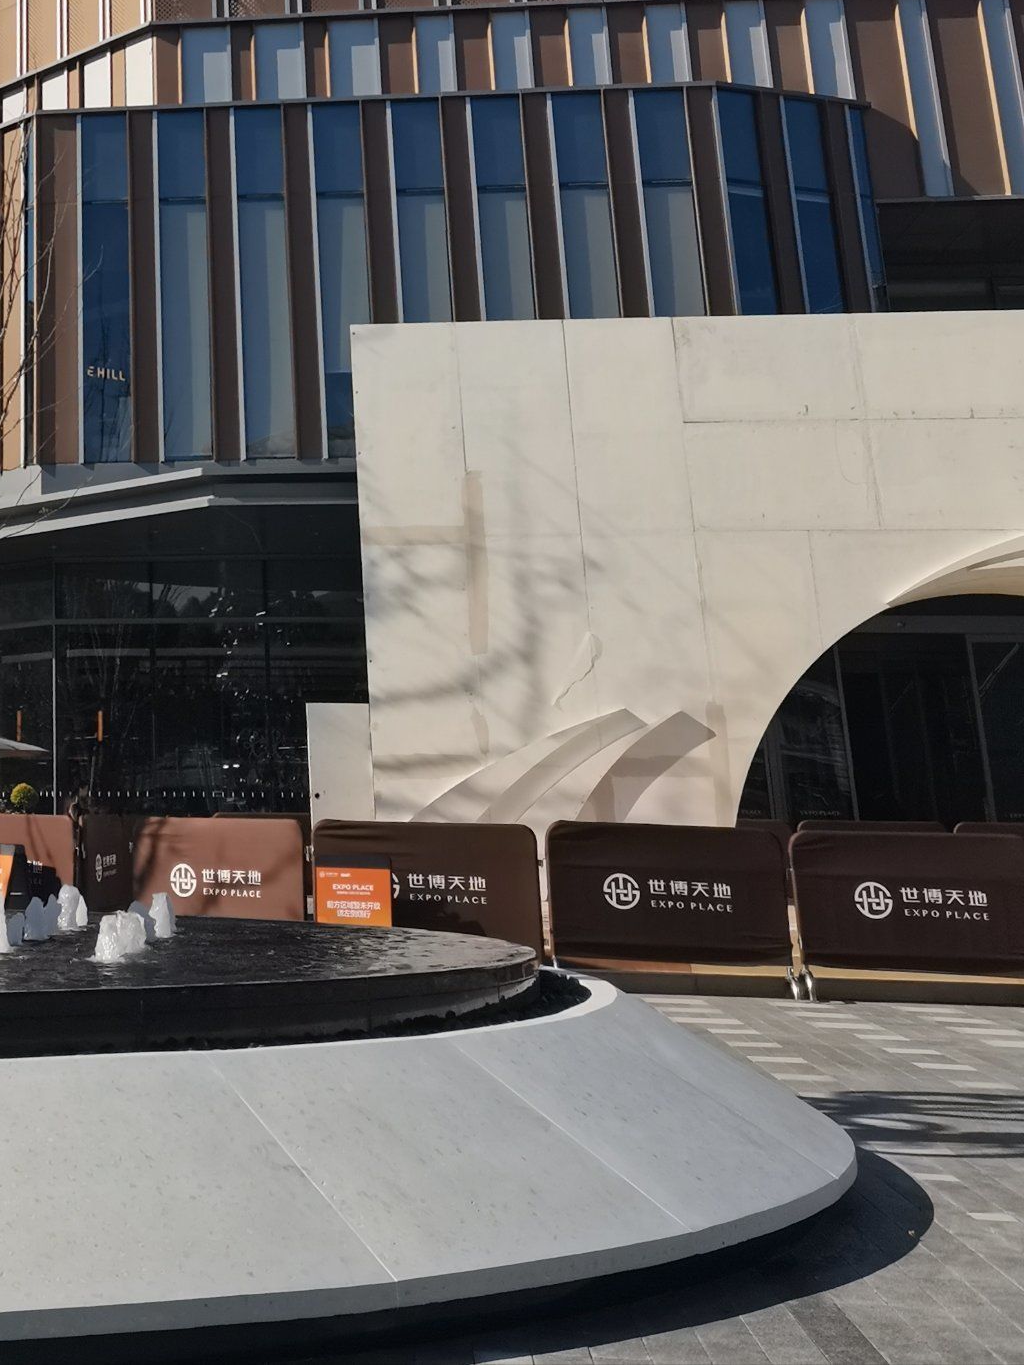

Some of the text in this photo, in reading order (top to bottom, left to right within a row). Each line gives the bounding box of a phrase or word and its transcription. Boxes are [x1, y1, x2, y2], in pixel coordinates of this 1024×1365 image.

[201, 868, 262, 886] 世博天地
[406, 872, 487, 892] 世博天地
[202, 887, 262, 899] EXPO PLACE
[647, 879, 732, 899] 世博天地
[898, 886, 989, 907] 世博天地
[409, 893, 488, 905] EXPO PLACE
[650, 899, 734, 913] EXPO PLACE
[903, 908, 991, 921] EXPO PLACE
